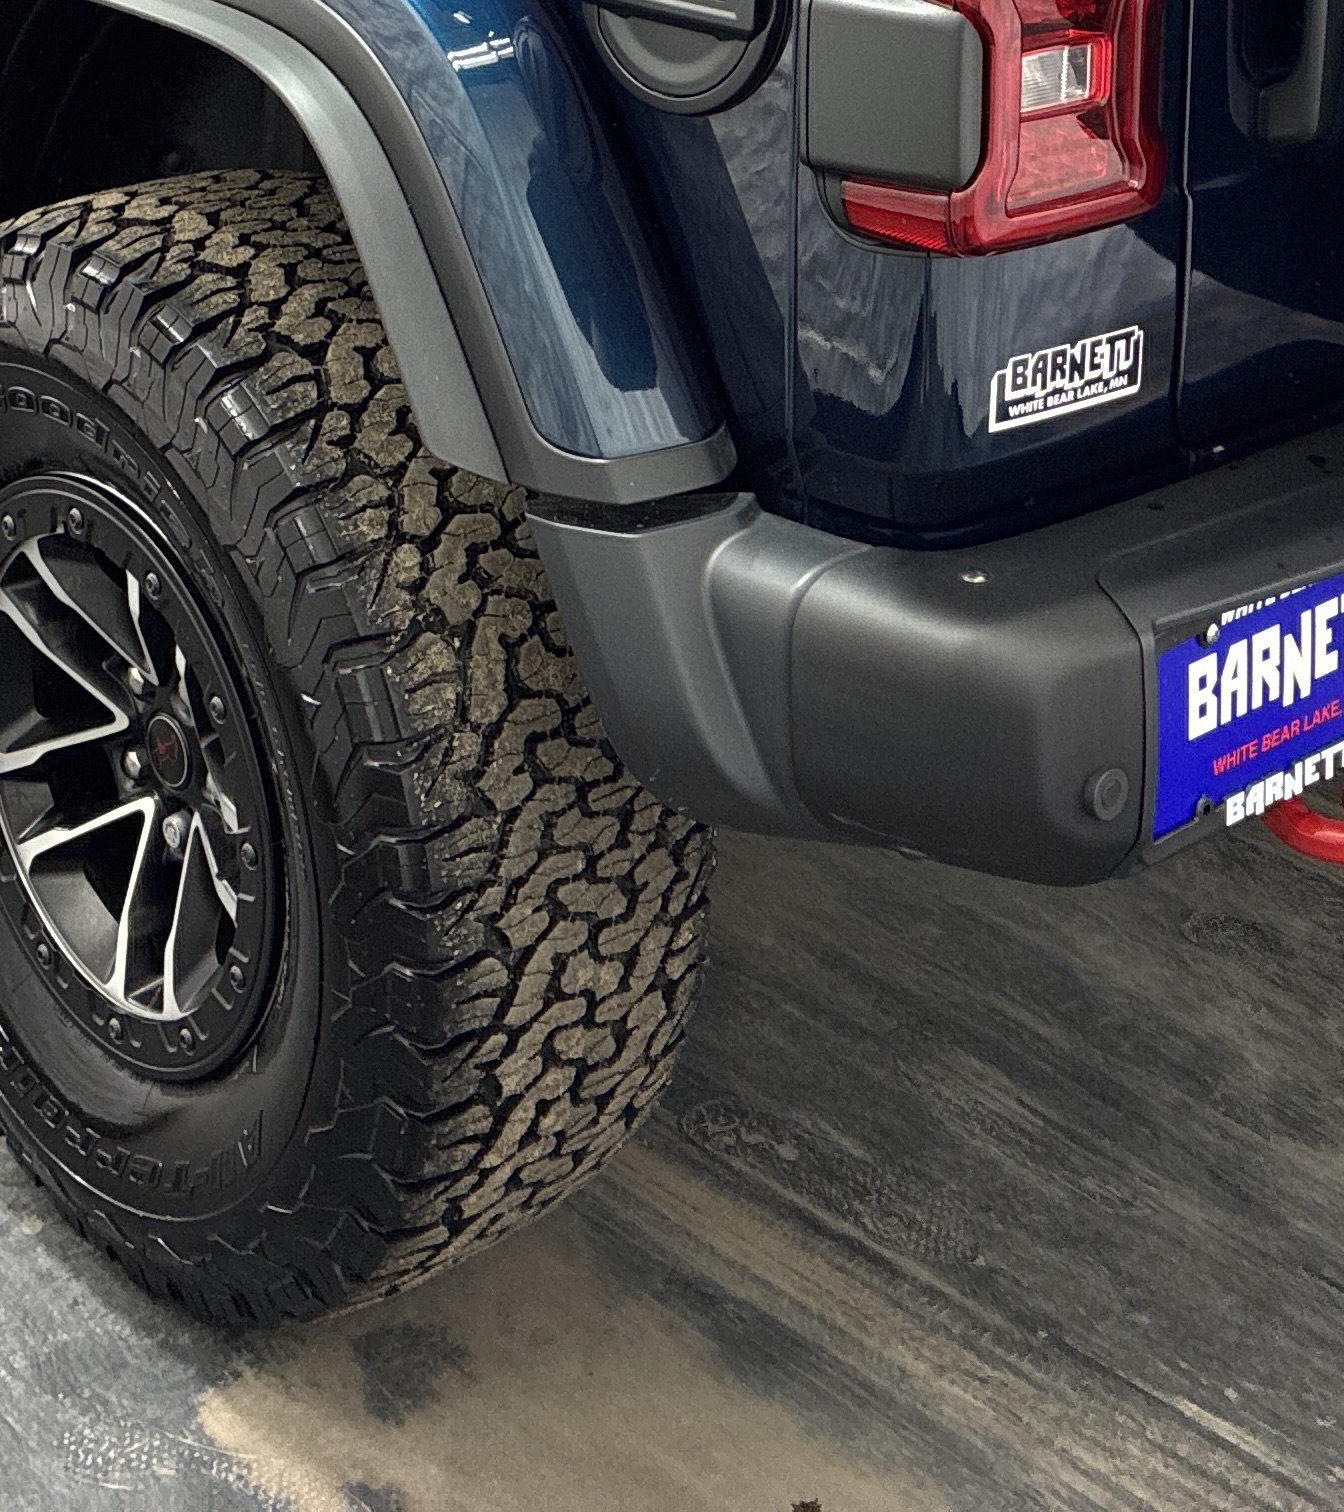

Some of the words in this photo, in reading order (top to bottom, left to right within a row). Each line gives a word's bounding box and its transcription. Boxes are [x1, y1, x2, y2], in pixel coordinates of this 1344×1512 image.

[1009, 327, 1136, 393] BARNETT
[1008, 398, 1045, 417] WHITE
[1046, 390, 1075, 408] BEAR
[1077, 380, 1108, 400] LAKE,
[1109, 374, 1129, 391] MN
[1212, 739, 1259, 777] WHITE
[1260, 718, 1301, 752] BEAR
